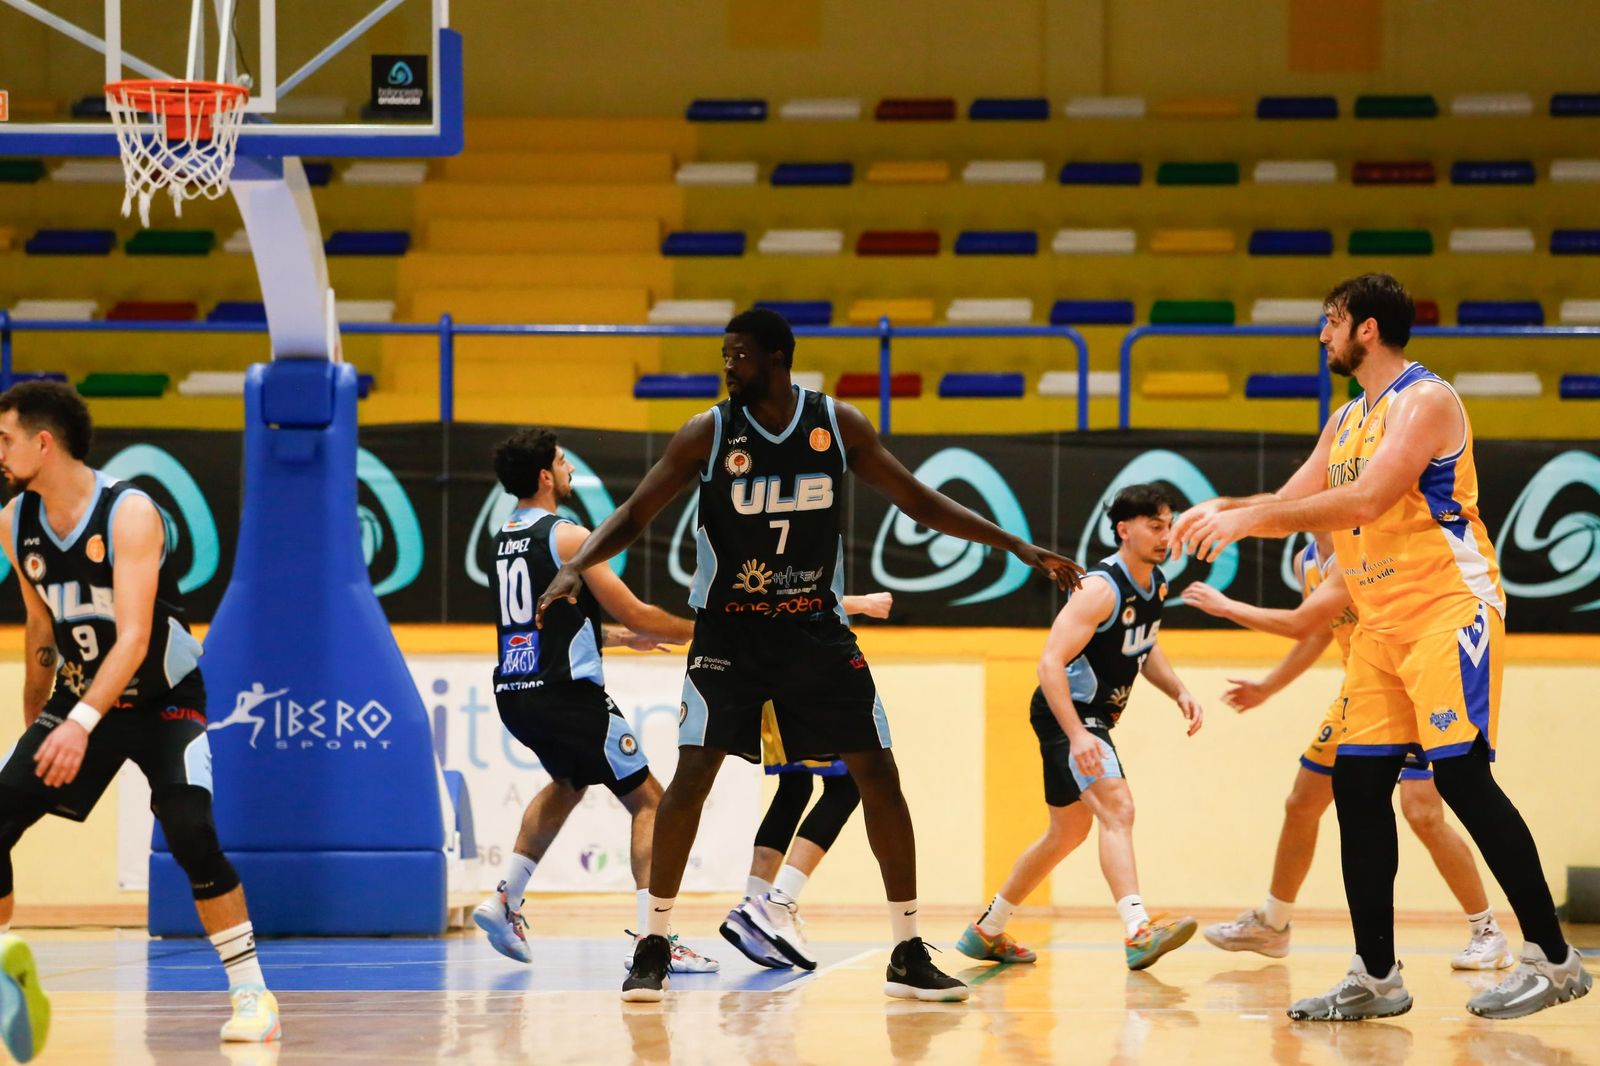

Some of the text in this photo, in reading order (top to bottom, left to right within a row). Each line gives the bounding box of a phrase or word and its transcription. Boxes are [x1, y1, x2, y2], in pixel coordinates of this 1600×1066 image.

[731, 472, 834, 515] ULB
[769, 519, 790, 555] 7
[496, 556, 533, 627] 10
[71, 624, 99, 662] 9
[275, 699, 392, 739] IBERO
[1318, 725, 1332, 743] 9
[275, 740, 391, 749] SPORT
